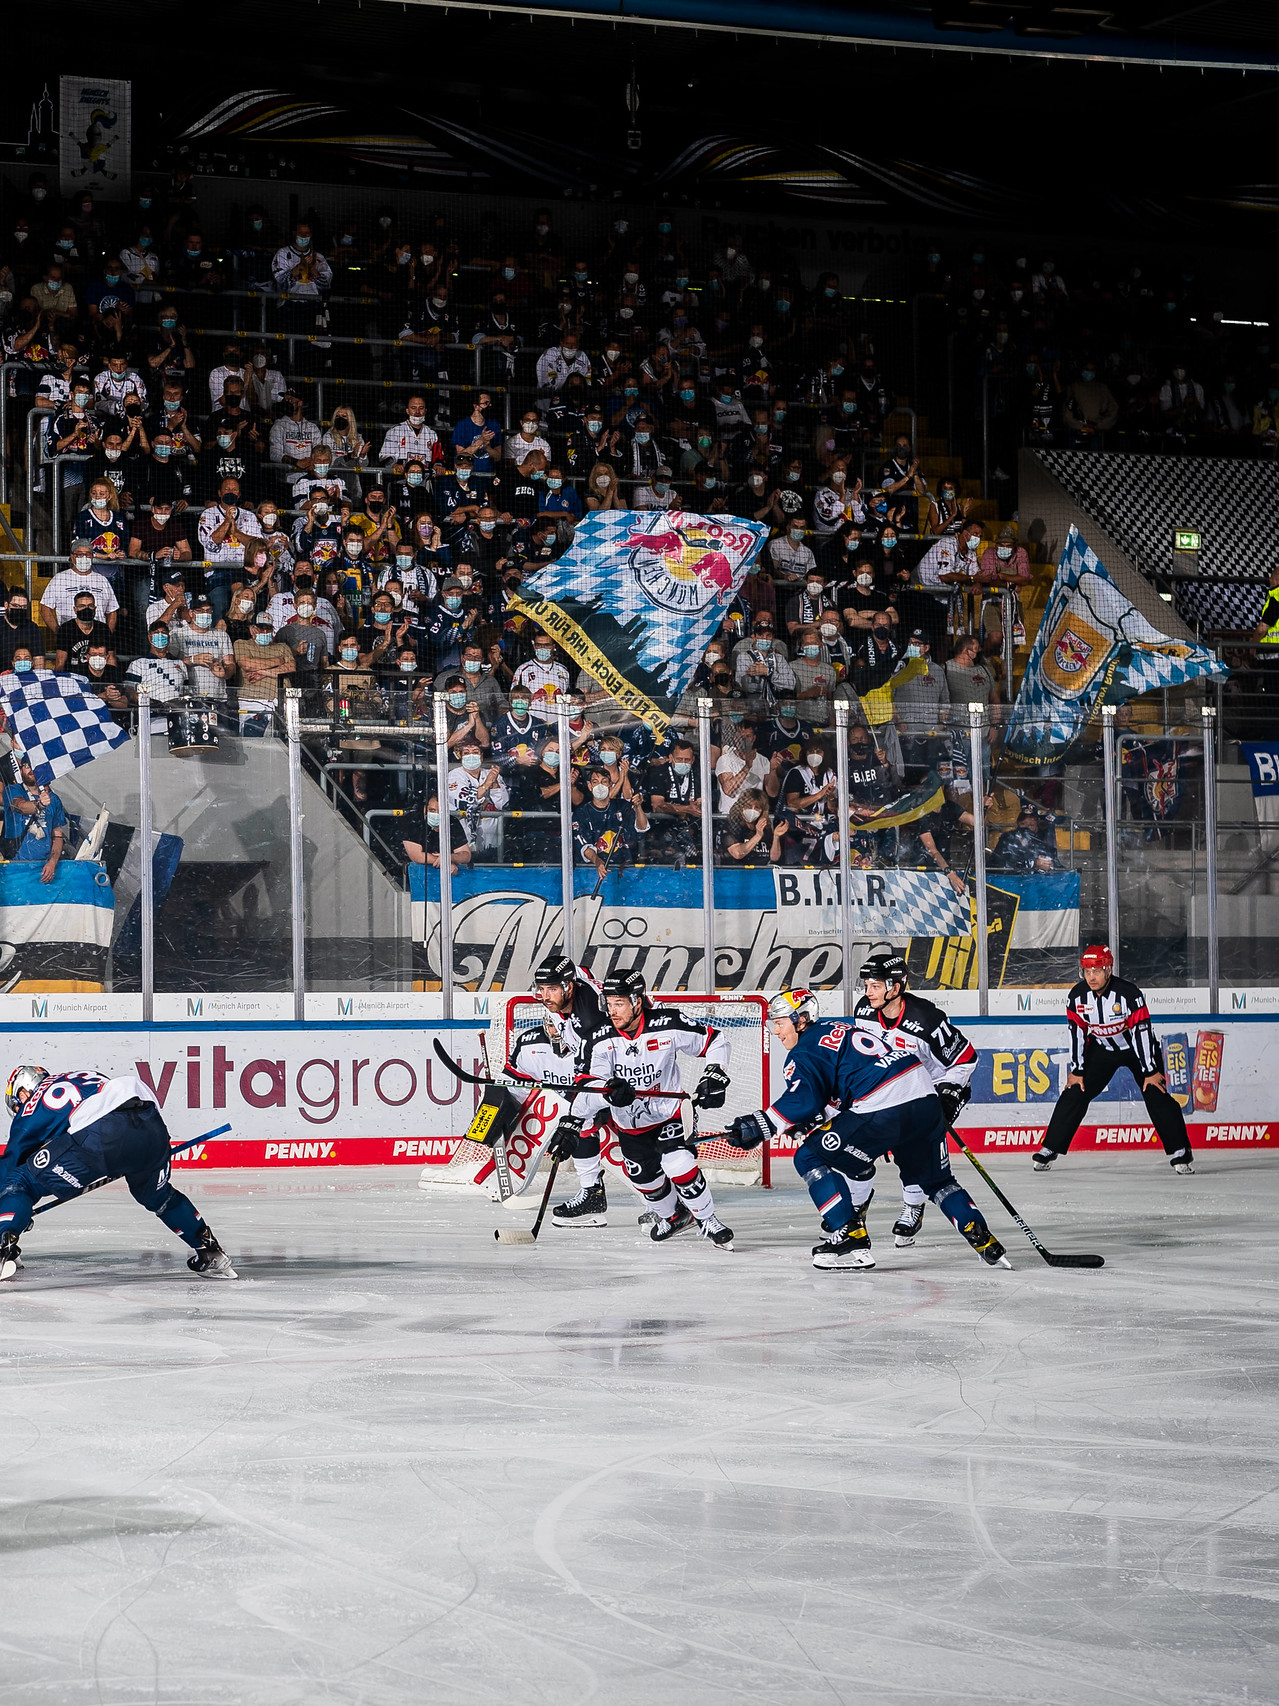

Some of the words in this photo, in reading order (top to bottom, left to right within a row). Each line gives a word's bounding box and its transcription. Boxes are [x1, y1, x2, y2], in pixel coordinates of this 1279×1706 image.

[237, 1001, 261, 1012] Airport
[388, 1001, 410, 1011] Airport
[1174, 996, 1197, 1006] Airport
[84, 1002, 108, 1013] Airport
[614, 1063, 655, 1077] Rhein
[626, 1068, 662, 1087] nergie
[478, 1113, 493, 1134] Köln
